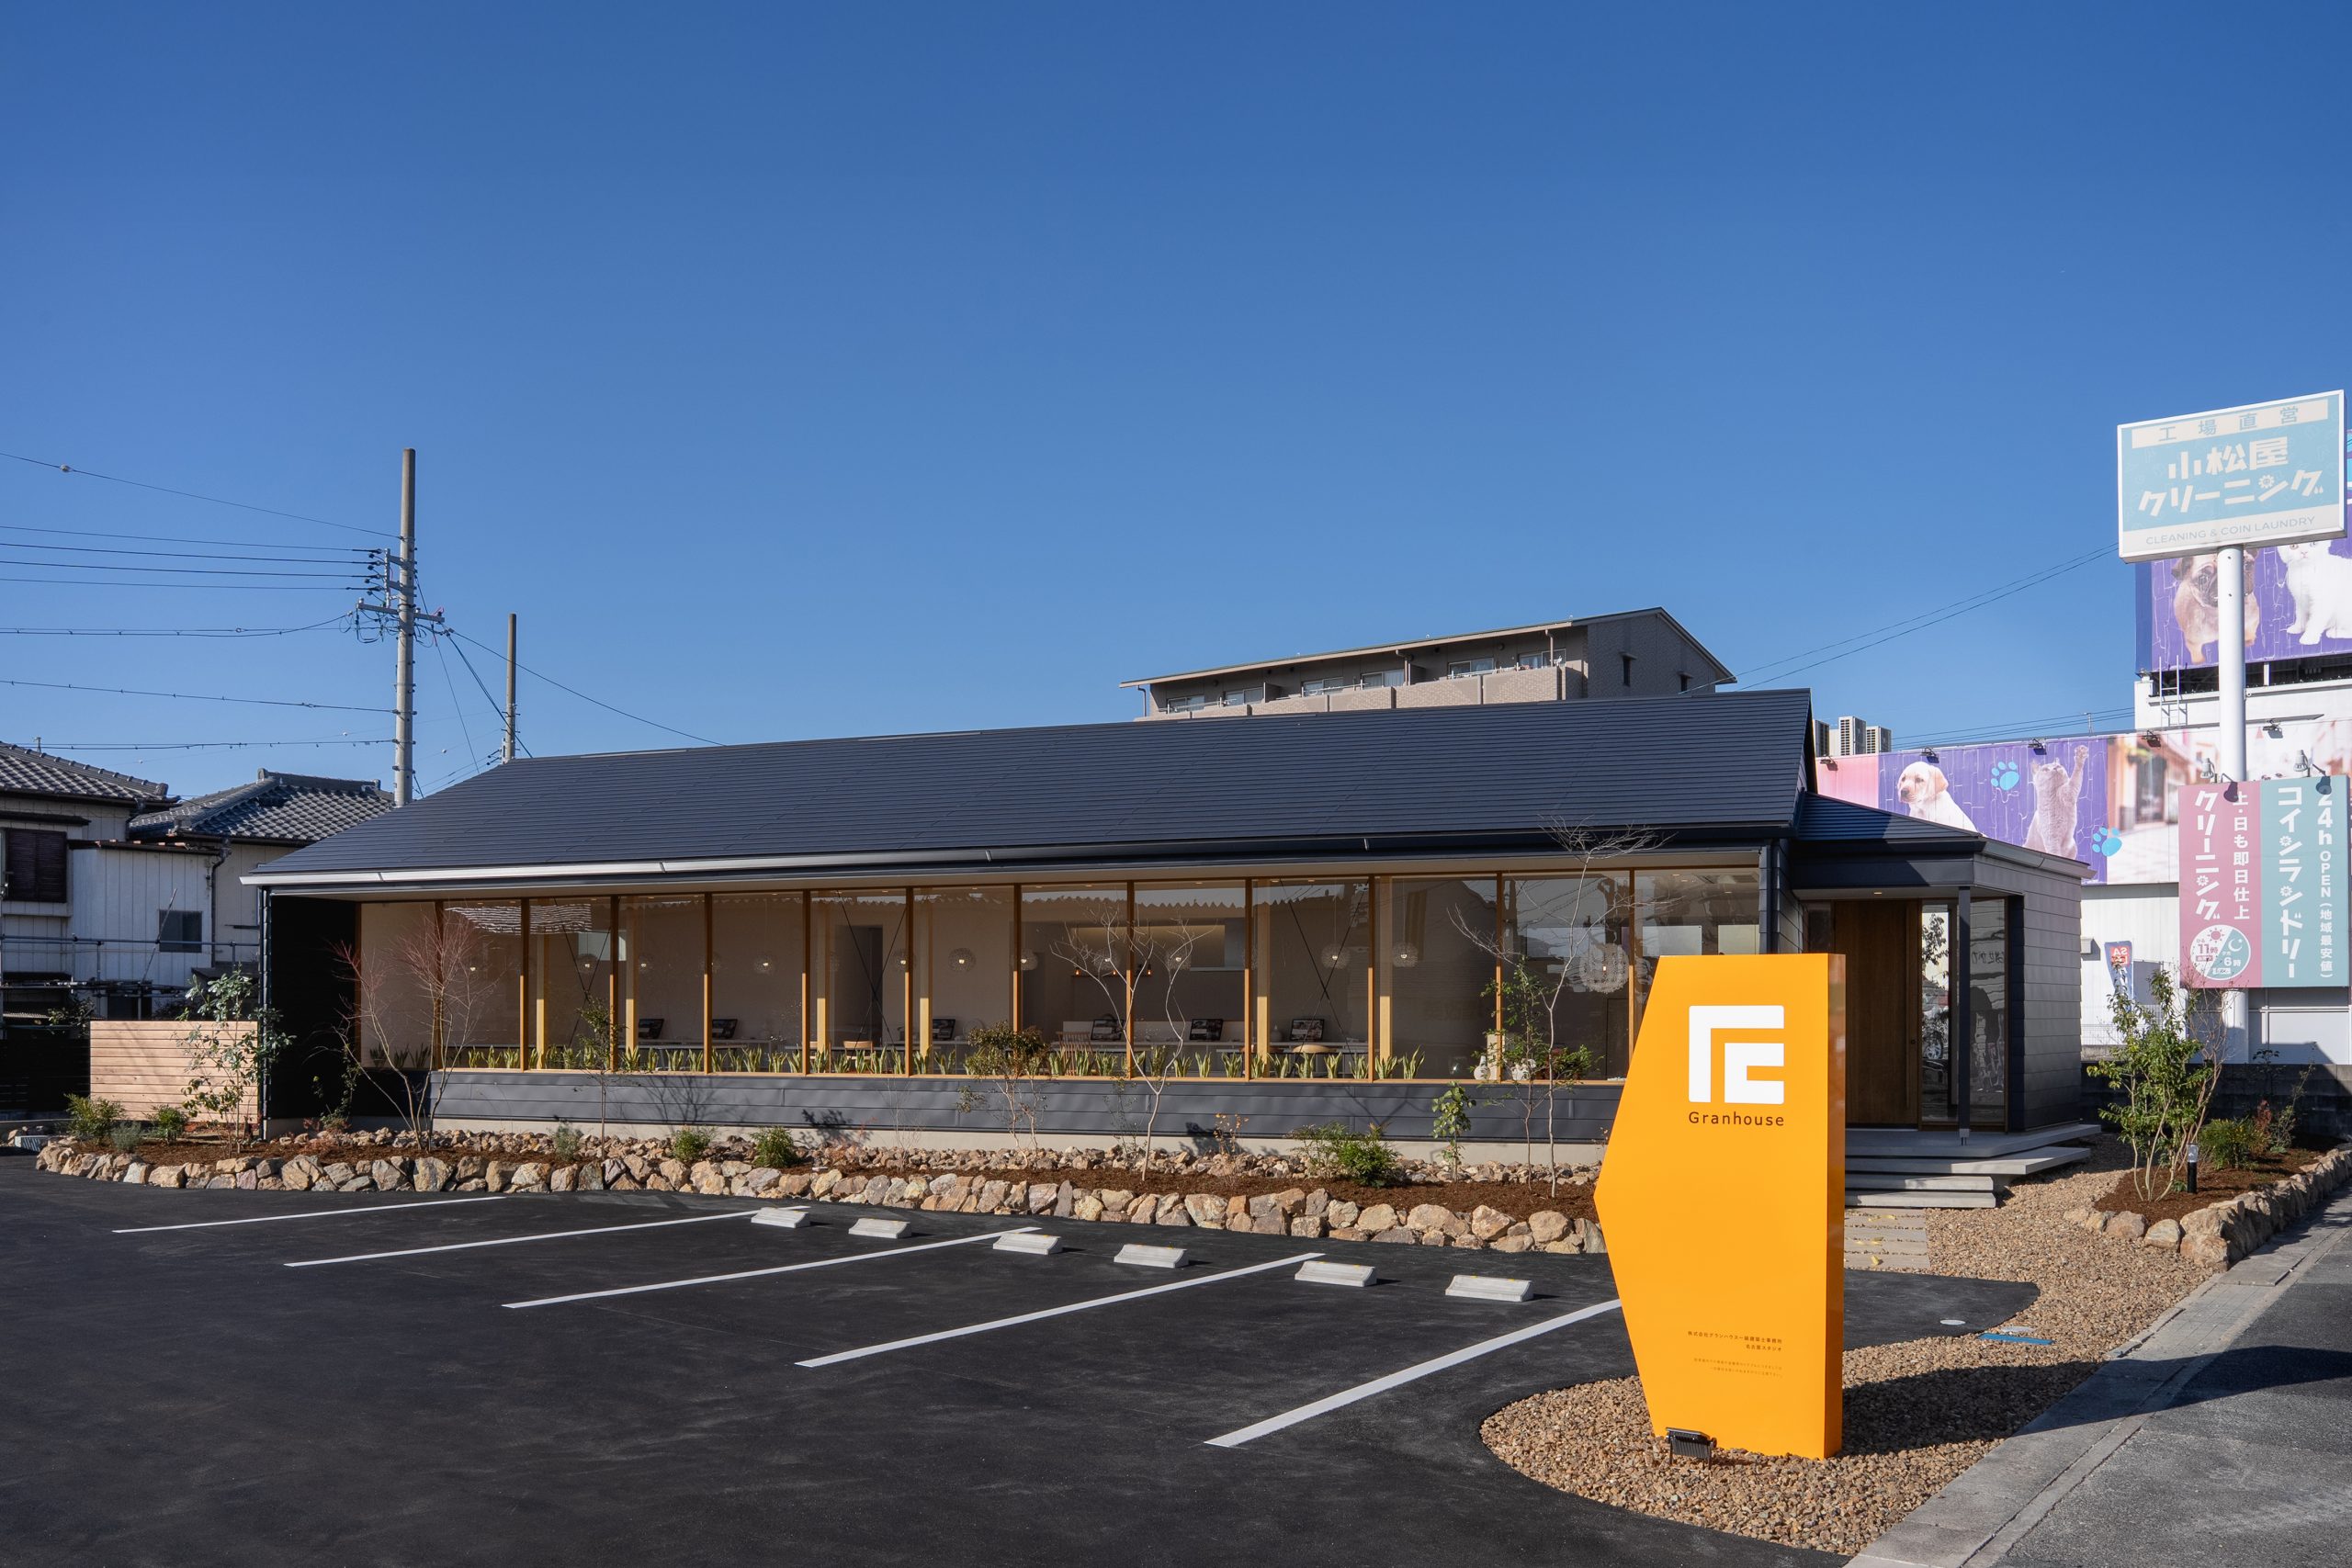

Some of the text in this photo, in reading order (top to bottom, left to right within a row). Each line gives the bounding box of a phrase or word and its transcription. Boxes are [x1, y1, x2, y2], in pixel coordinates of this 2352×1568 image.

[2159, 406, 2299, 442] 工場直営
[2168, 436, 2289, 479] 小松屋
[2138, 469, 2324, 516] クリーニング
[2146, 515, 2315, 545] CLEANING & COIN LAUNDRY
[2195, 790, 2221, 921] クリーニング
[2320, 850, 2332, 897] OPEN
[2278, 786, 2303, 978] コインランドリー
[1689, 1111, 1784, 1126] Granhouse
